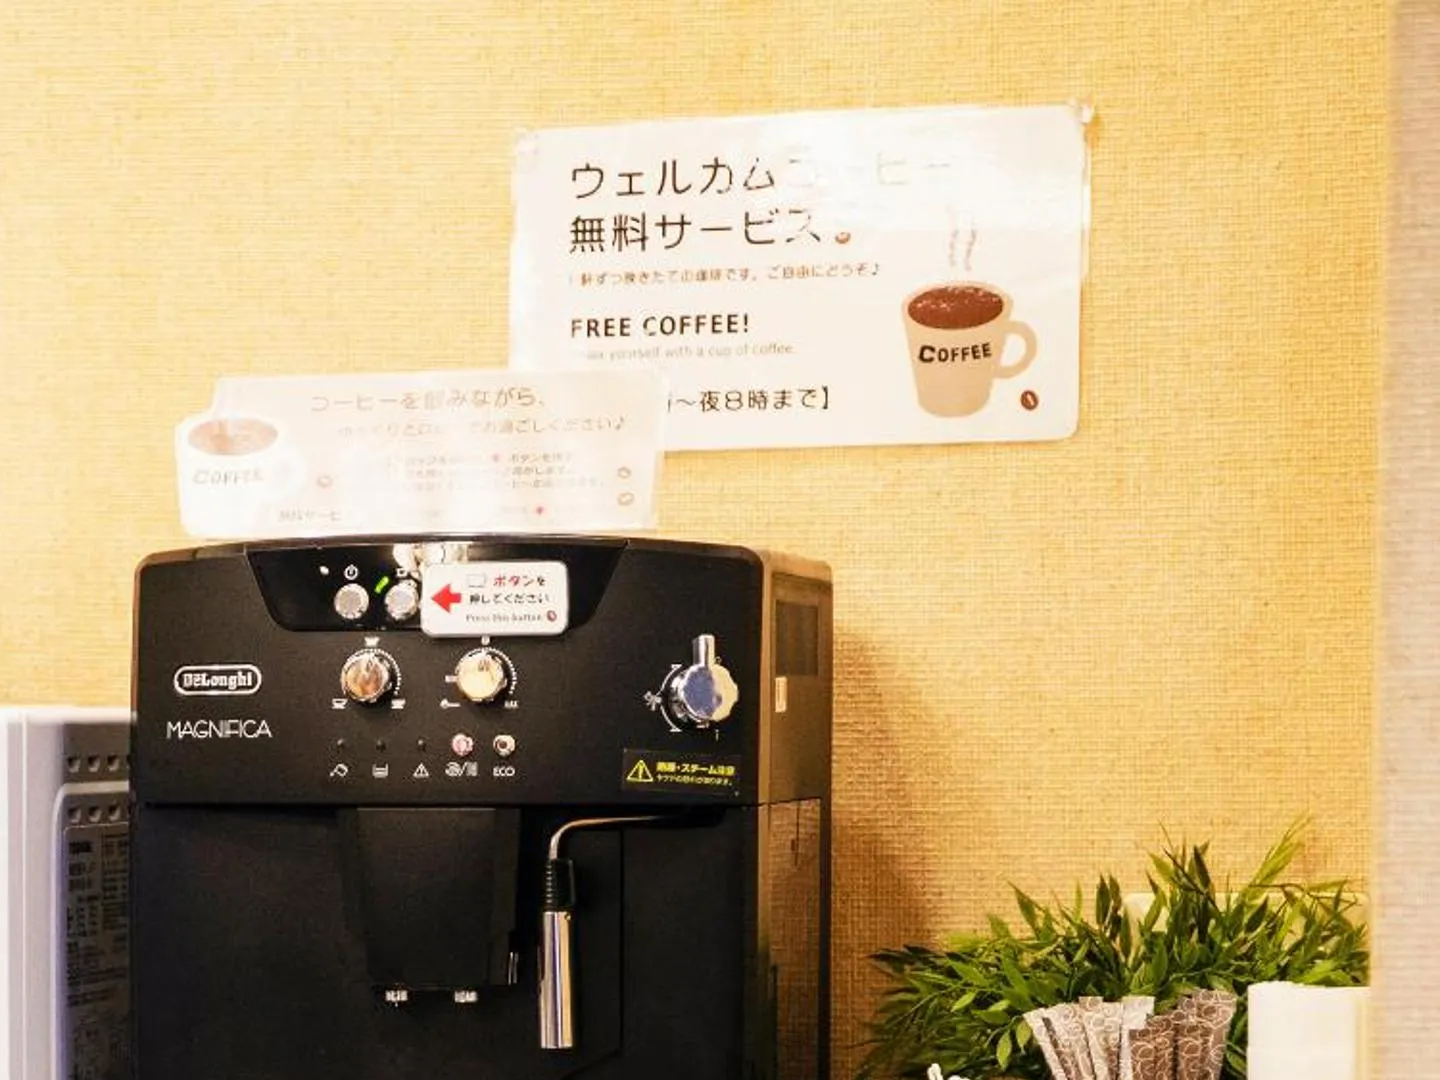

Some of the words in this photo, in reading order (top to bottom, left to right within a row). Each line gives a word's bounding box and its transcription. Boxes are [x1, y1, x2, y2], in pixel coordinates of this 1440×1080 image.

[571, 155, 952, 199] ウェルカムコヒー
[569, 209, 822, 254] 無料サービス
[570, 317, 632, 338] FREE
[642, 312, 750, 336] COFFEE!
[665, 345, 692, 359] with
[708, 346, 732, 361] cup
[918, 342, 993, 364] COFFEE
[166, 719, 273, 739] MAGNIFICA
[493, 765, 516, 777] ECO
